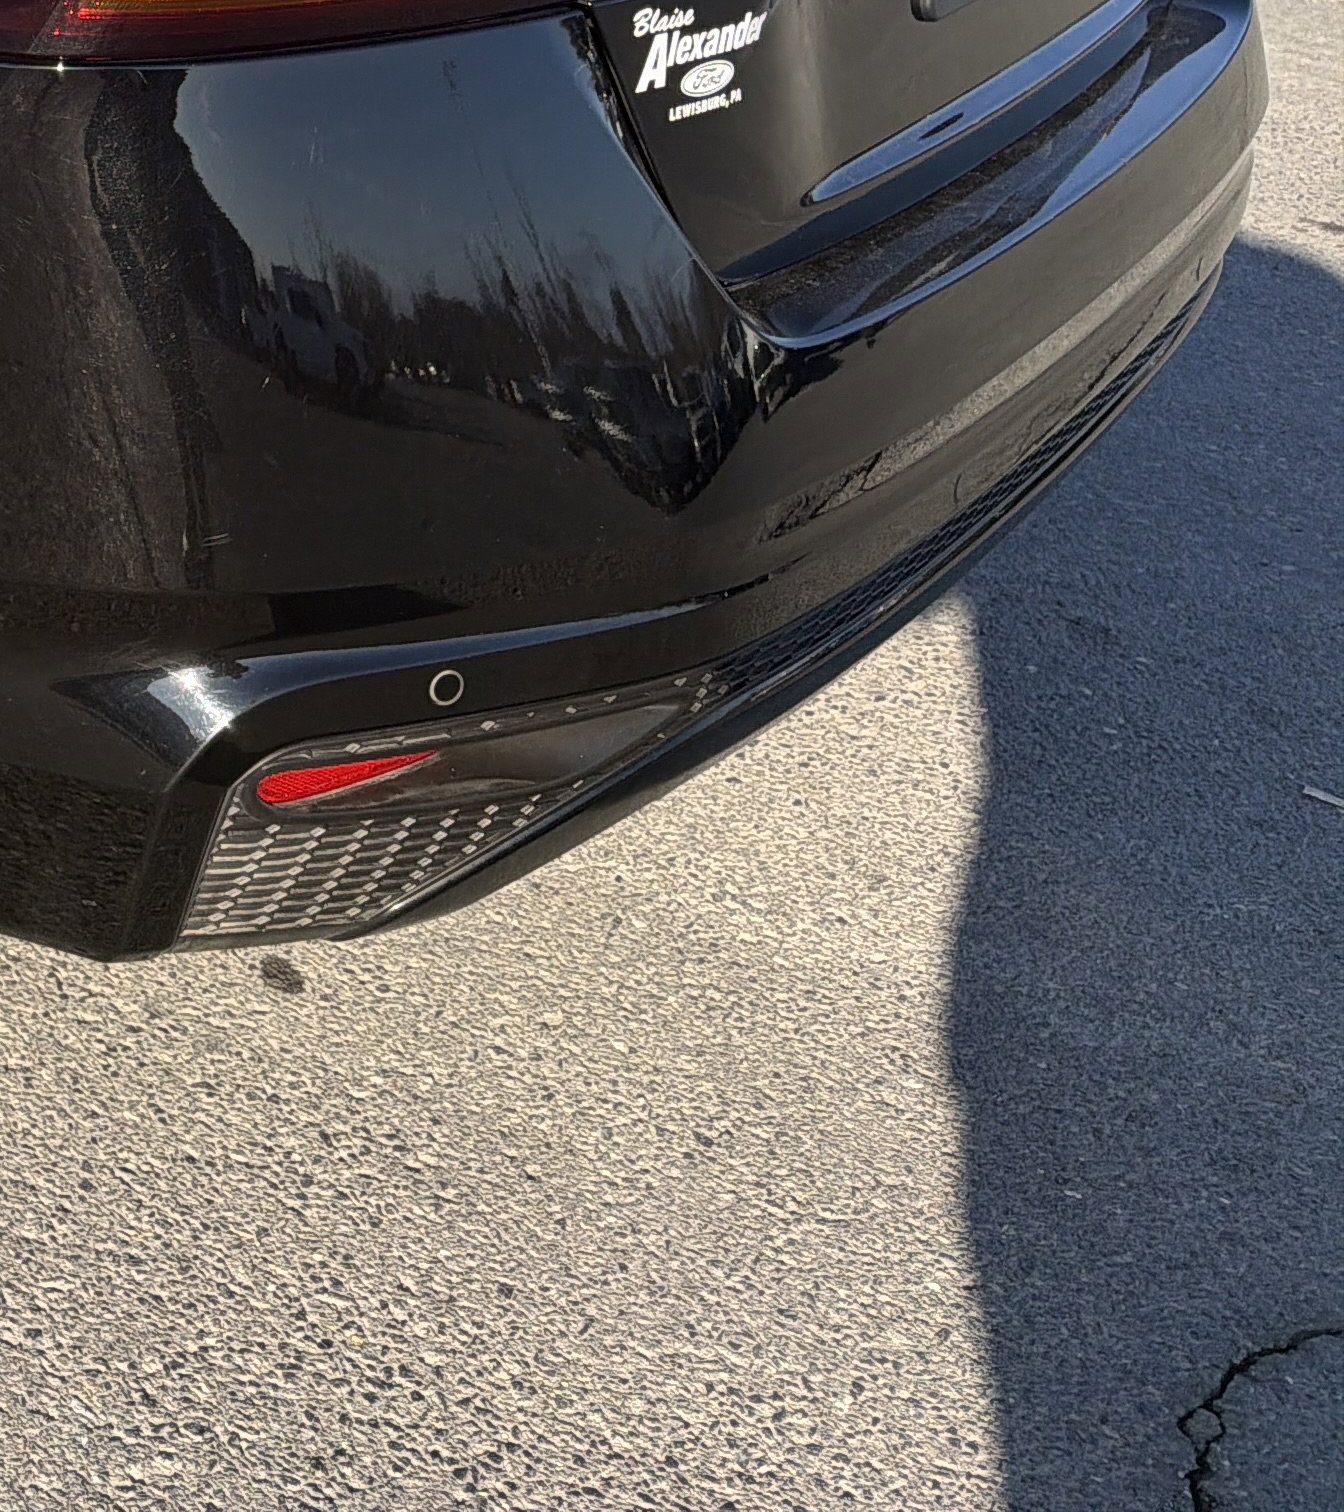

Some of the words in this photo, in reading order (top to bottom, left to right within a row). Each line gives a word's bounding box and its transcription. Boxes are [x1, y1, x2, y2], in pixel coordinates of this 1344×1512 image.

[633, 7, 695, 38] Blaise
[634, 11, 768, 94] Alexander
[729, 88, 742, 105] PA
